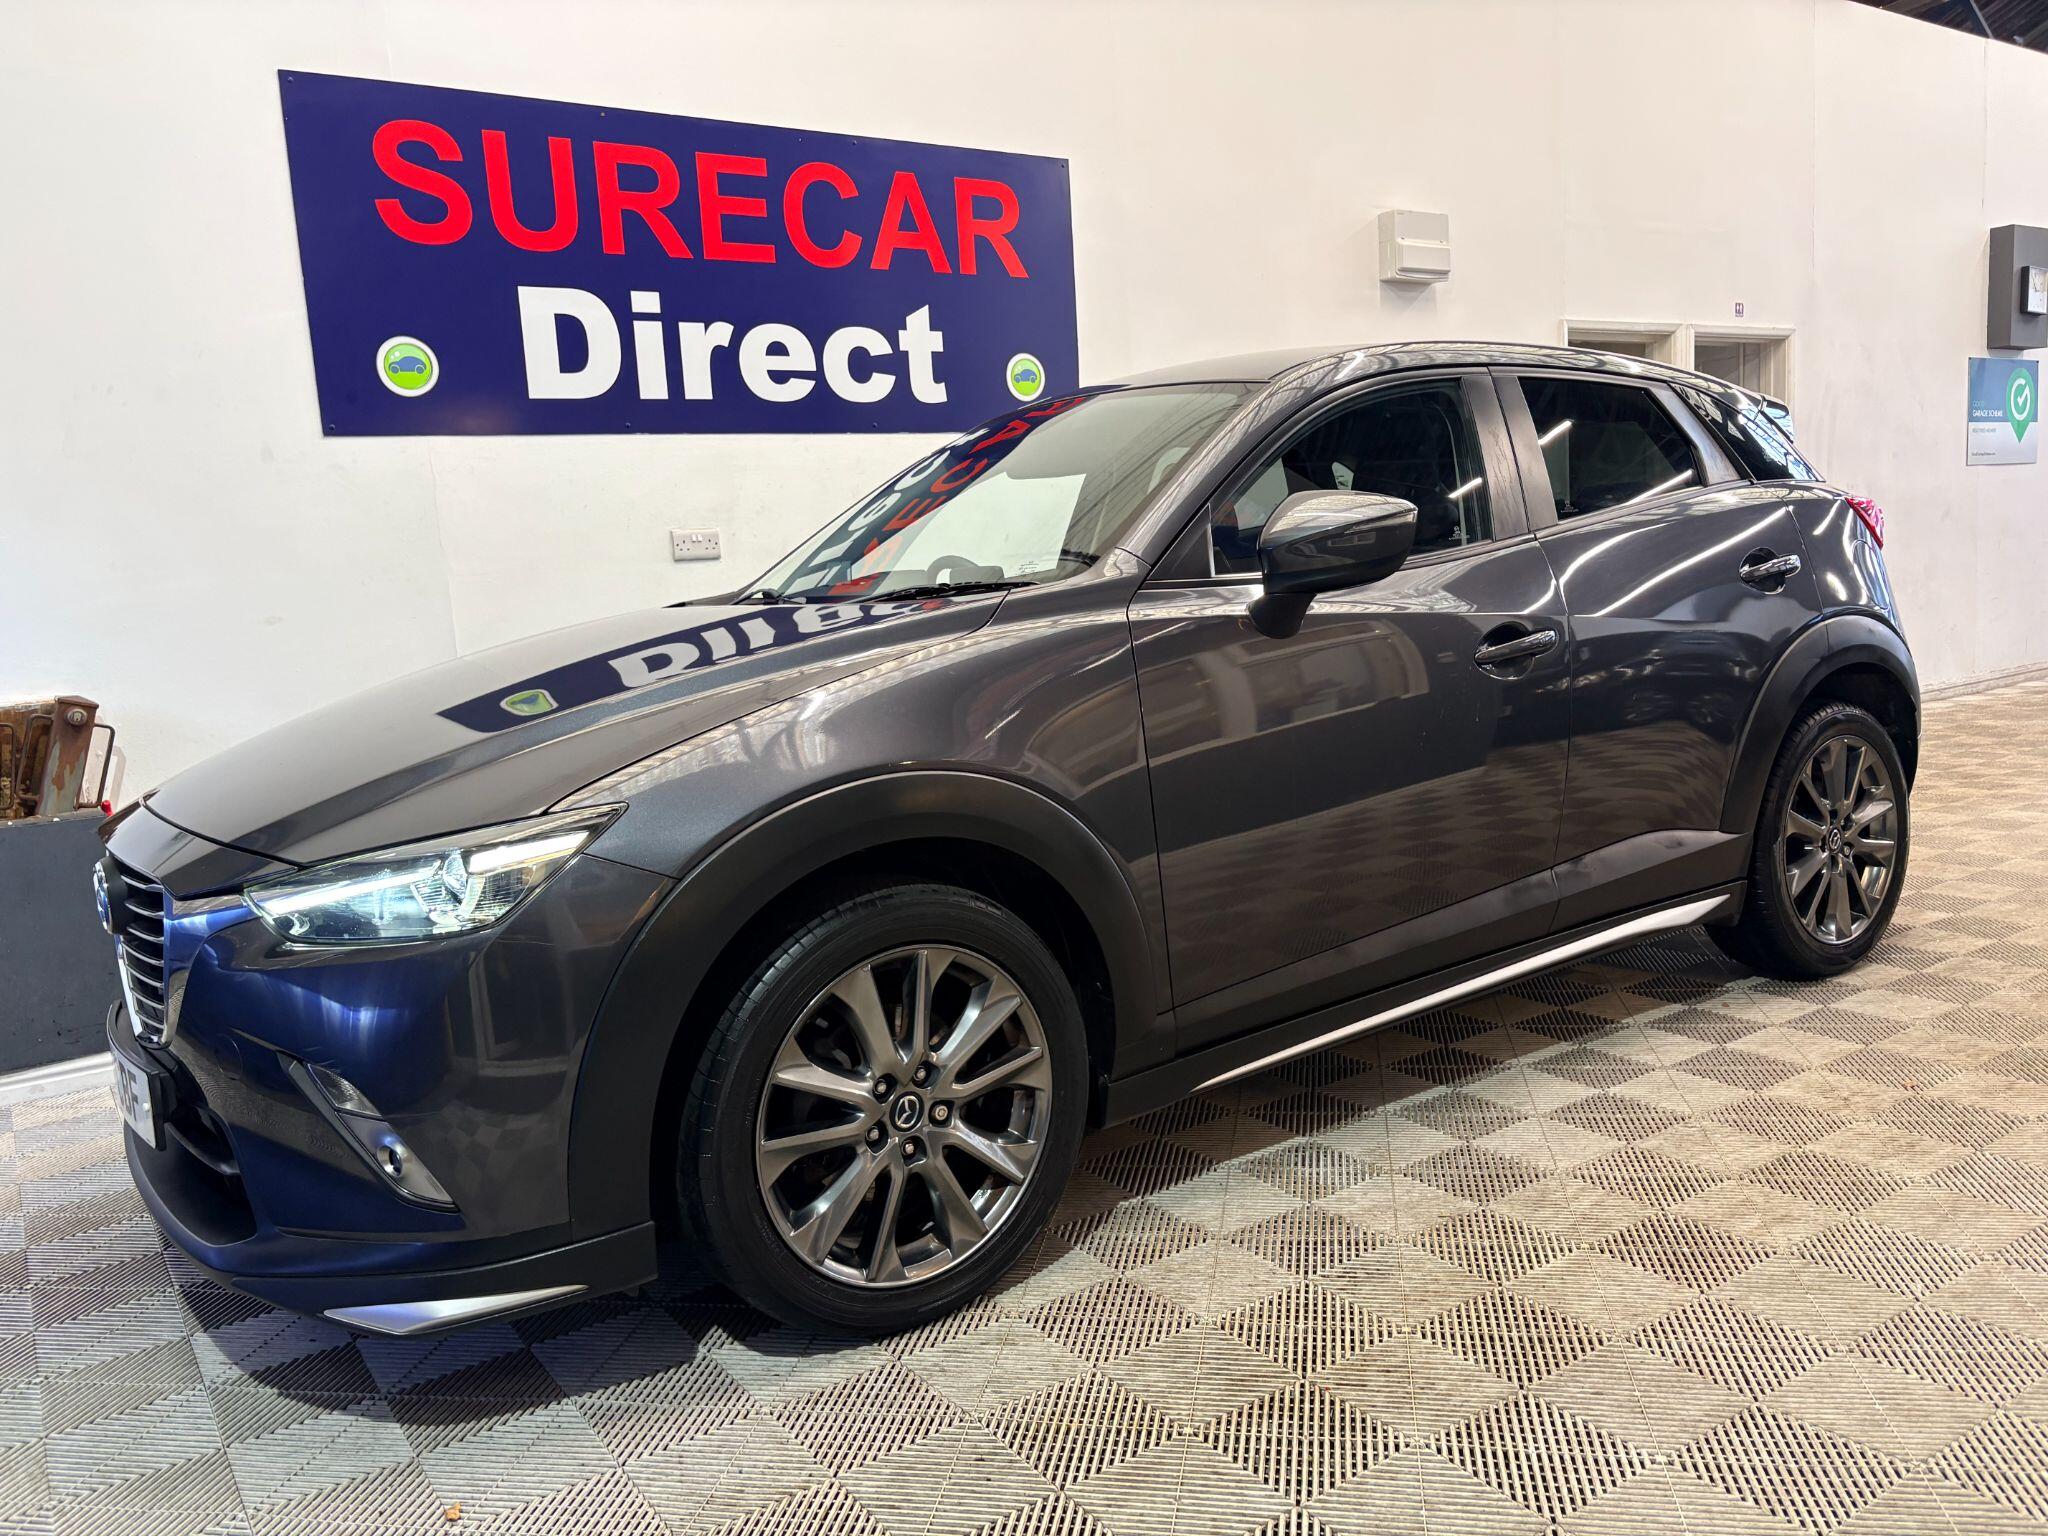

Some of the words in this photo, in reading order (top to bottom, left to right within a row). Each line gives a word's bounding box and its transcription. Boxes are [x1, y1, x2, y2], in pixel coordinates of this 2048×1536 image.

[373, 119, 1028, 278] SURECAR
[517, 286, 947, 404] Direct
[1972, 409, 1988, 417] GARAGE
